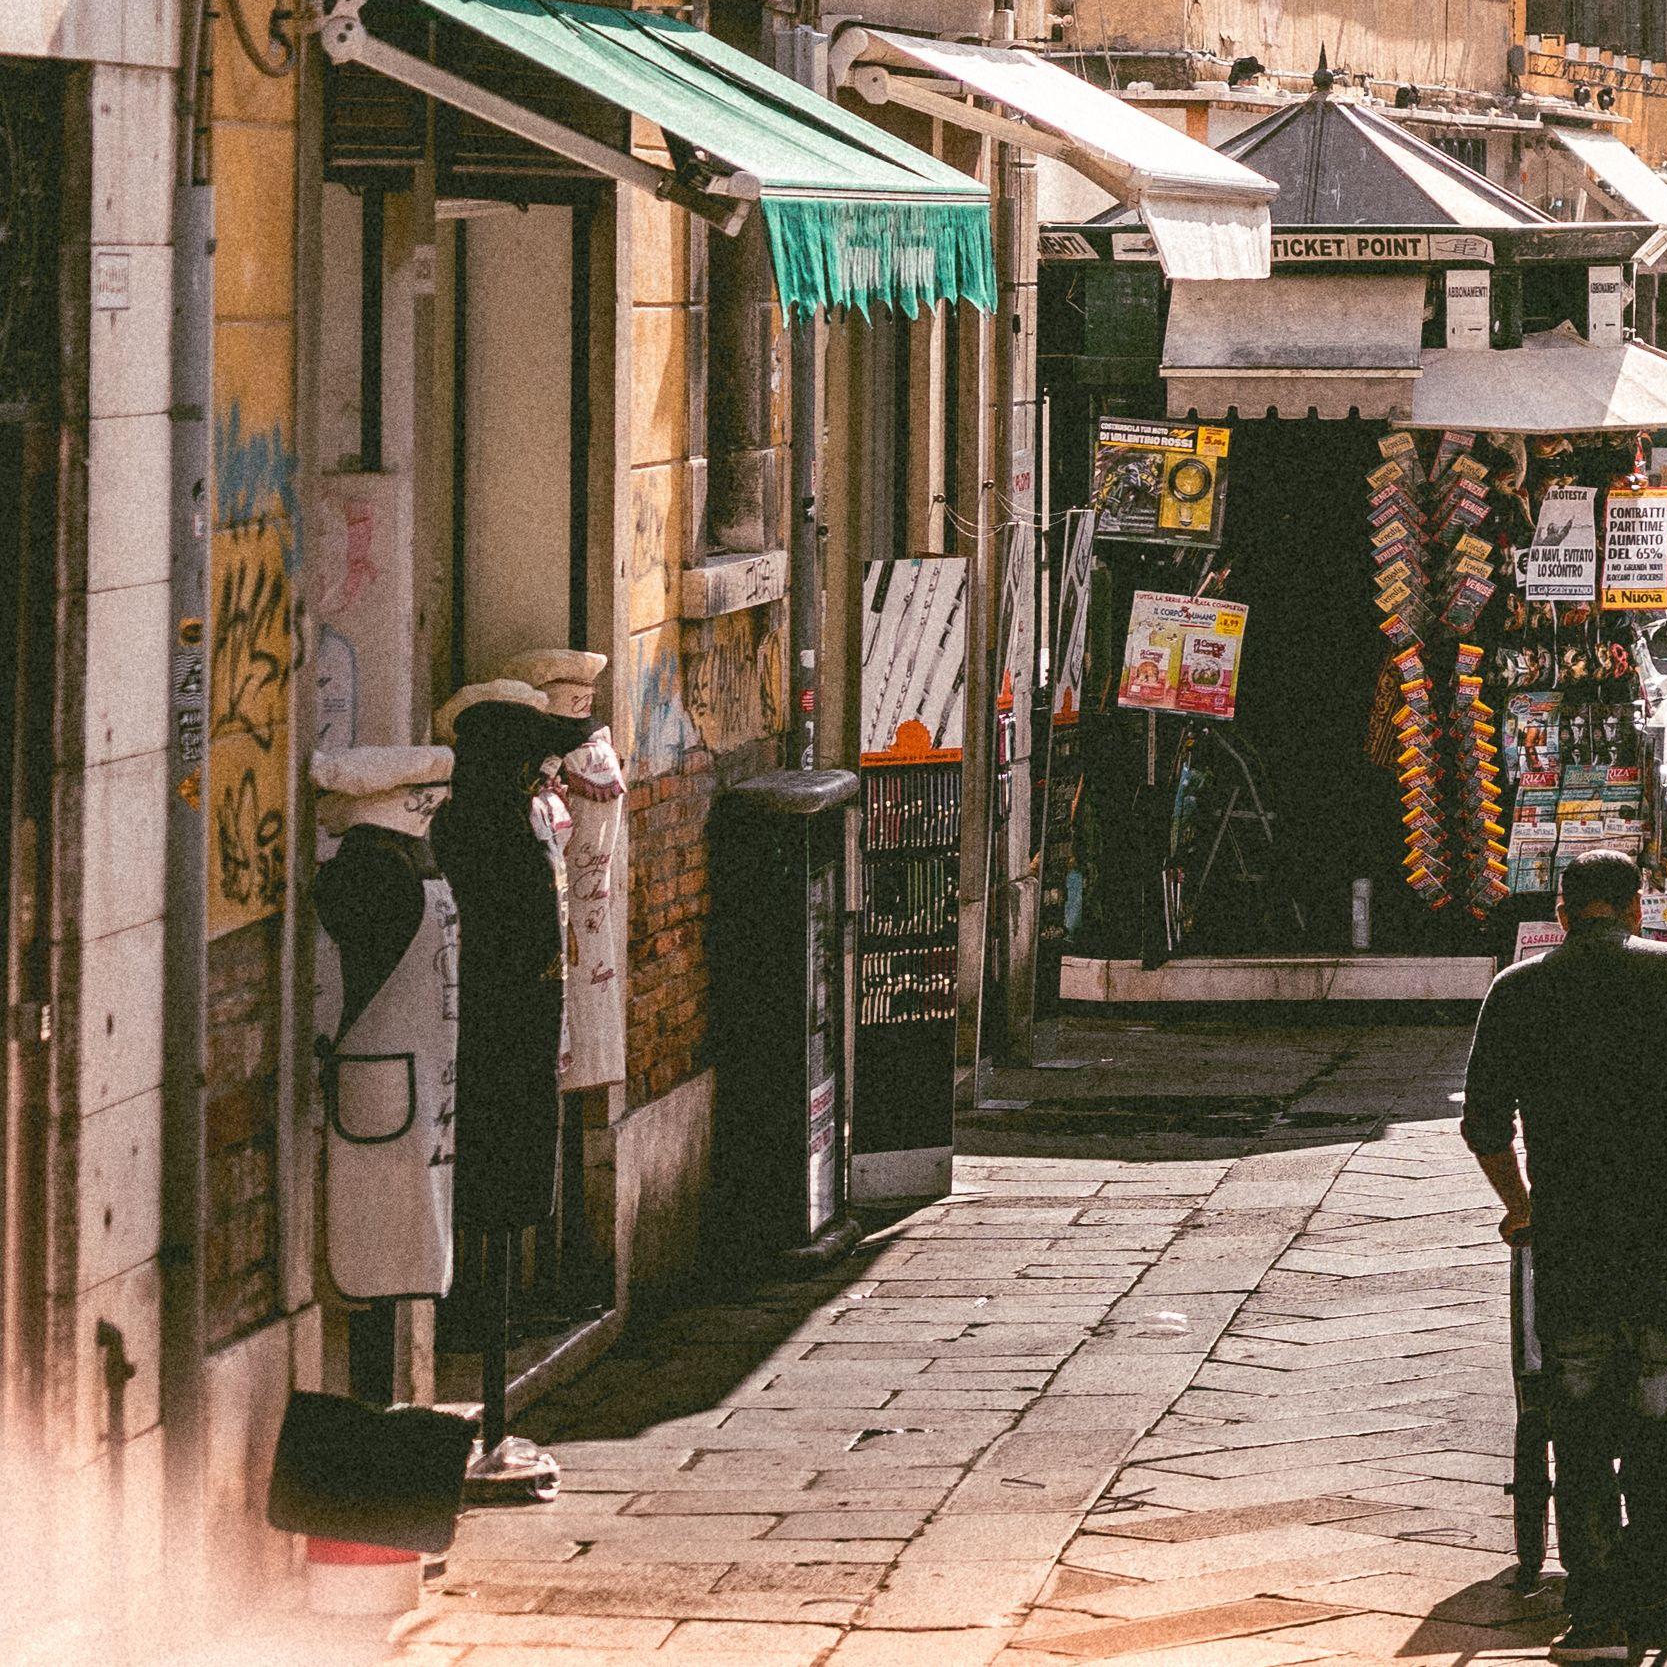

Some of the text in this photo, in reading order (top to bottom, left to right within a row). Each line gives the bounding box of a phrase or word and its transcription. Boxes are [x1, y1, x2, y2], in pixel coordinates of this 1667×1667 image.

[1271, 238, 1421, 257] TICKET POINT
[1448, 286, 1488, 298] ABBONAMENTI
[1100, 432, 1110, 441] DI
[1111, 433, 1160, 446] VALENTINO
[1161, 437, 1193, 448] ROSSI
[1610, 507, 1665, 519] CONTRATTI
[1610, 521, 1664, 532] PART TIME
[1608, 534, 1664, 546] AUMENTO
[1531, 548, 1540, 561] NO
[1564, 549, 1594, 563] EVITATO
[1608, 548, 1663, 560] DEL 65%
[1537, 563, 1583, 578] LO SCONTRO
[1529, 586, 1592, 595] IL GAZZETTINO
[1622, 590, 1663, 603] Nuova
[1160, 608, 1183, 618] CORPO
[1191, 613, 1217, 622] UMANO
[1522, 773, 1547, 785] RIZA
[1607, 768, 1630, 781] RIZA
